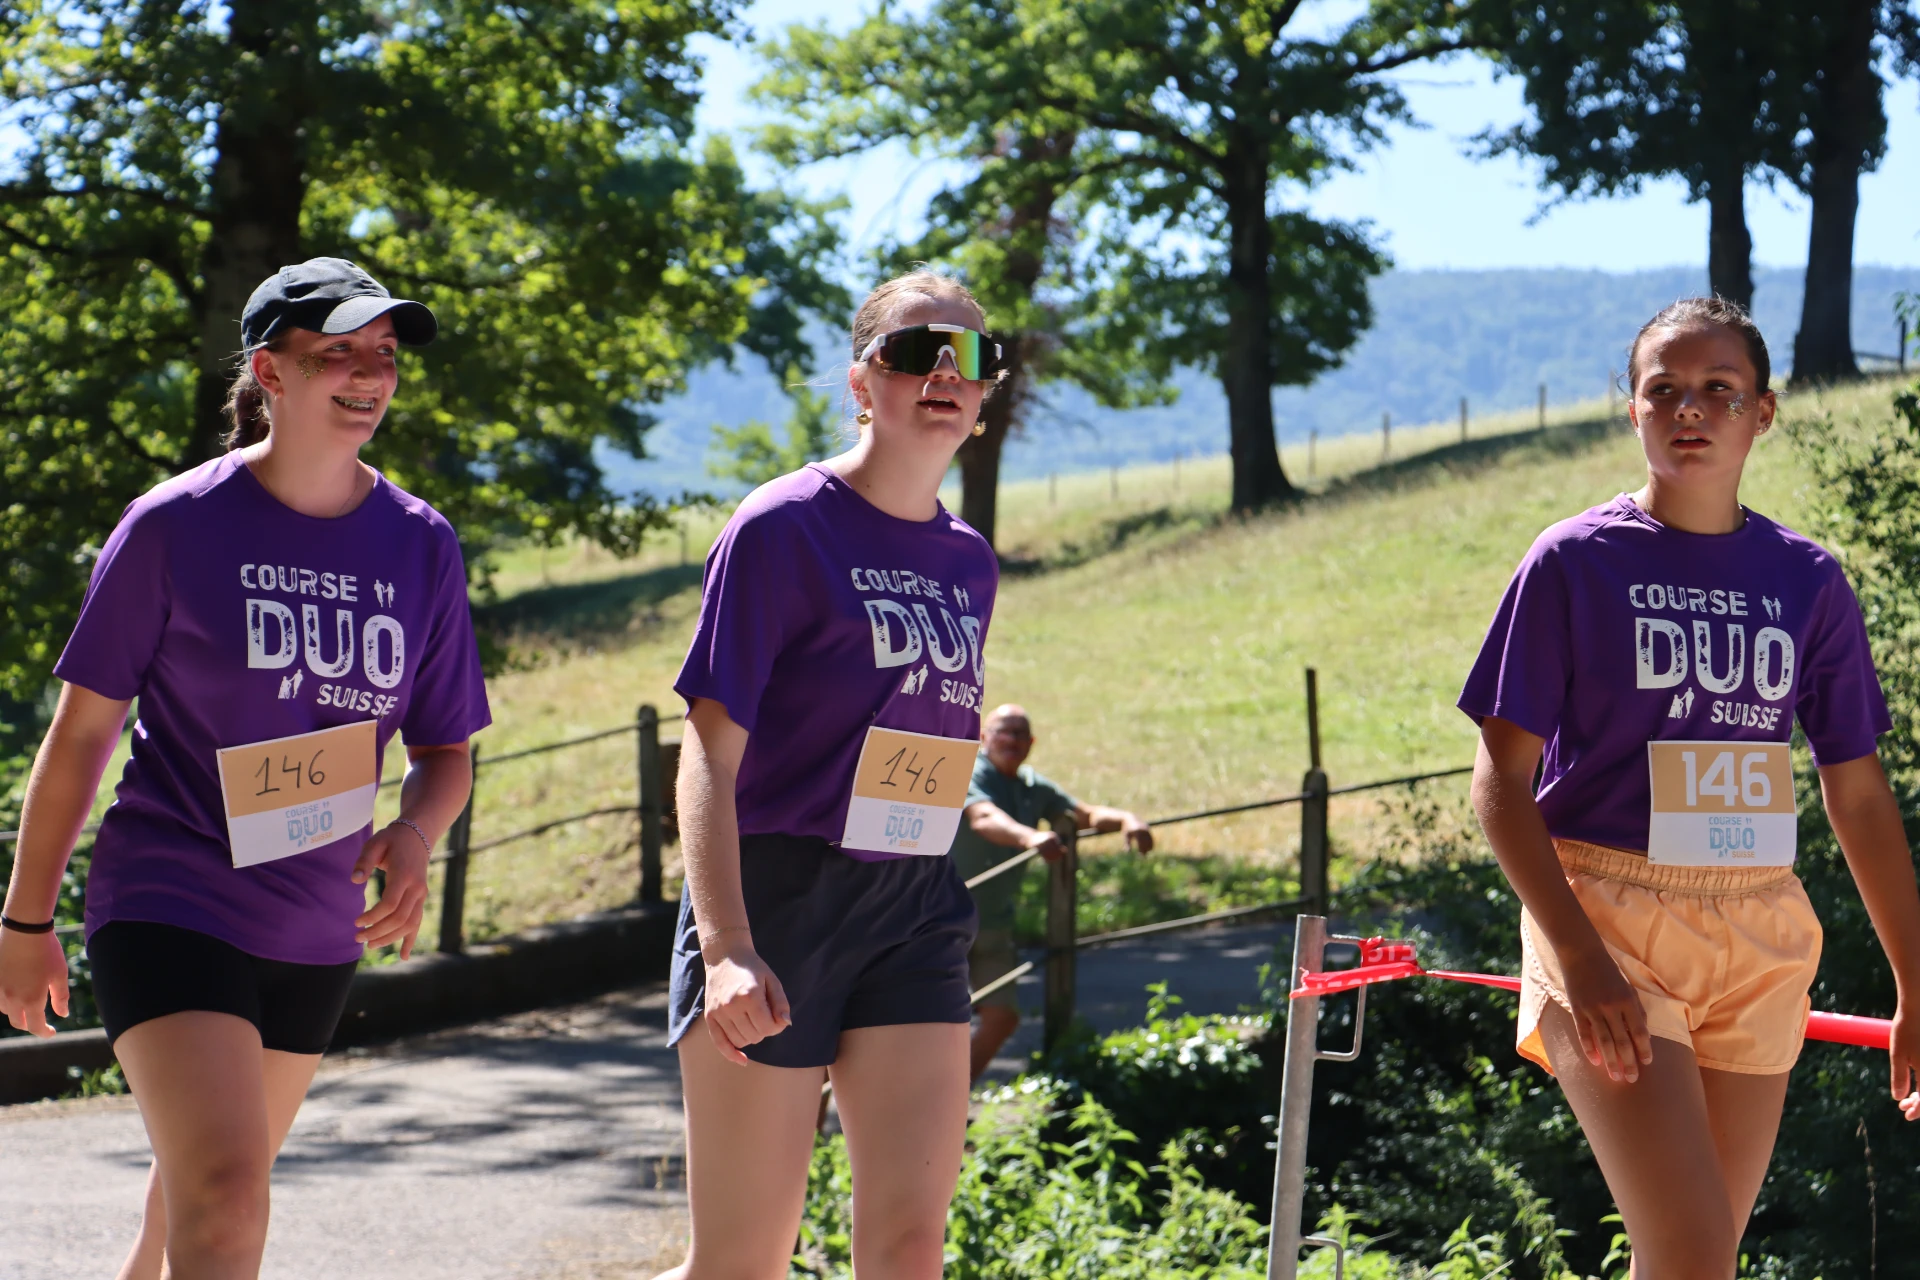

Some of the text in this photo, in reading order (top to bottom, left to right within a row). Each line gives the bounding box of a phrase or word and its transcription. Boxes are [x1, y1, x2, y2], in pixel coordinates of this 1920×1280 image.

[240, 564, 358, 602] COURSE
[851, 567, 947, 605] COURSE
[1629, 584, 1748, 616] COURSE
[246, 598, 405, 689] DUO
[863, 599, 985, 686] DUO
[1635, 617, 1795, 701] DUO
[317, 684, 399, 716] SUISSE
[1710, 700, 1782, 731] SUISSE
[255, 749, 325, 796] 146
[880, 747, 946, 794] 146
[1682, 751, 1771, 807] 146
[285, 803, 319, 818] COURSE
[287, 810, 333, 840] DUO
[889, 804, 917, 815] COURSE
[1708, 816, 1742, 825] COURSE
[884, 815, 924, 840] DUO
[1709, 827, 1755, 850] DUO
[1731, 850, 1756, 858] SUISSE
